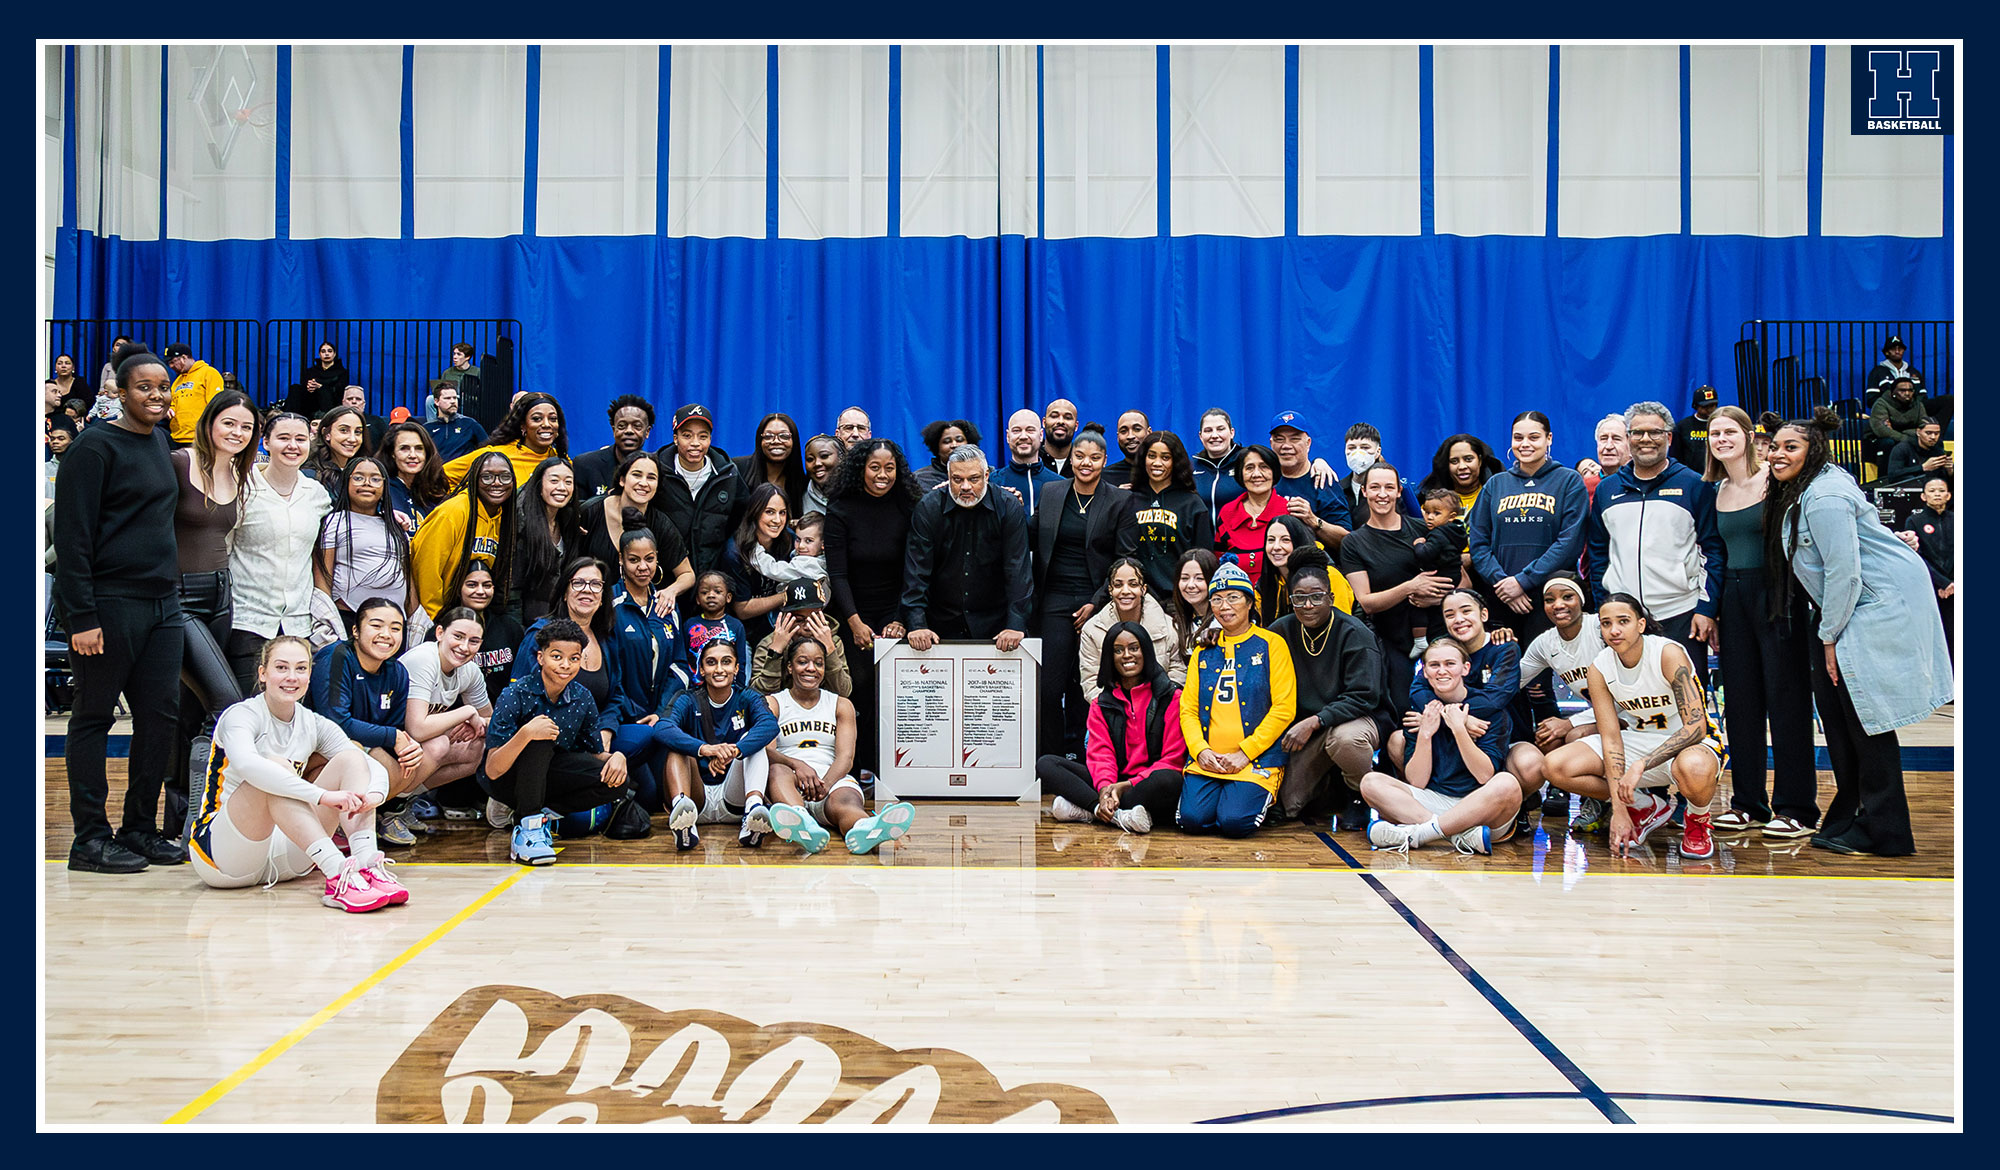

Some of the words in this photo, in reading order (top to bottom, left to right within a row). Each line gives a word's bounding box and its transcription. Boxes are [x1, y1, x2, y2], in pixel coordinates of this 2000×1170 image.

[1496, 492, 1557, 515] HUMBER
[1135, 508, 1178, 531] UMBER
[1139, 535, 1176, 543] AWKS
[794, 586, 807, 600] NY
[1216, 675, 1236, 704] 5
[731, 714, 746, 731] H
[780, 720, 837, 737] HUMBER
